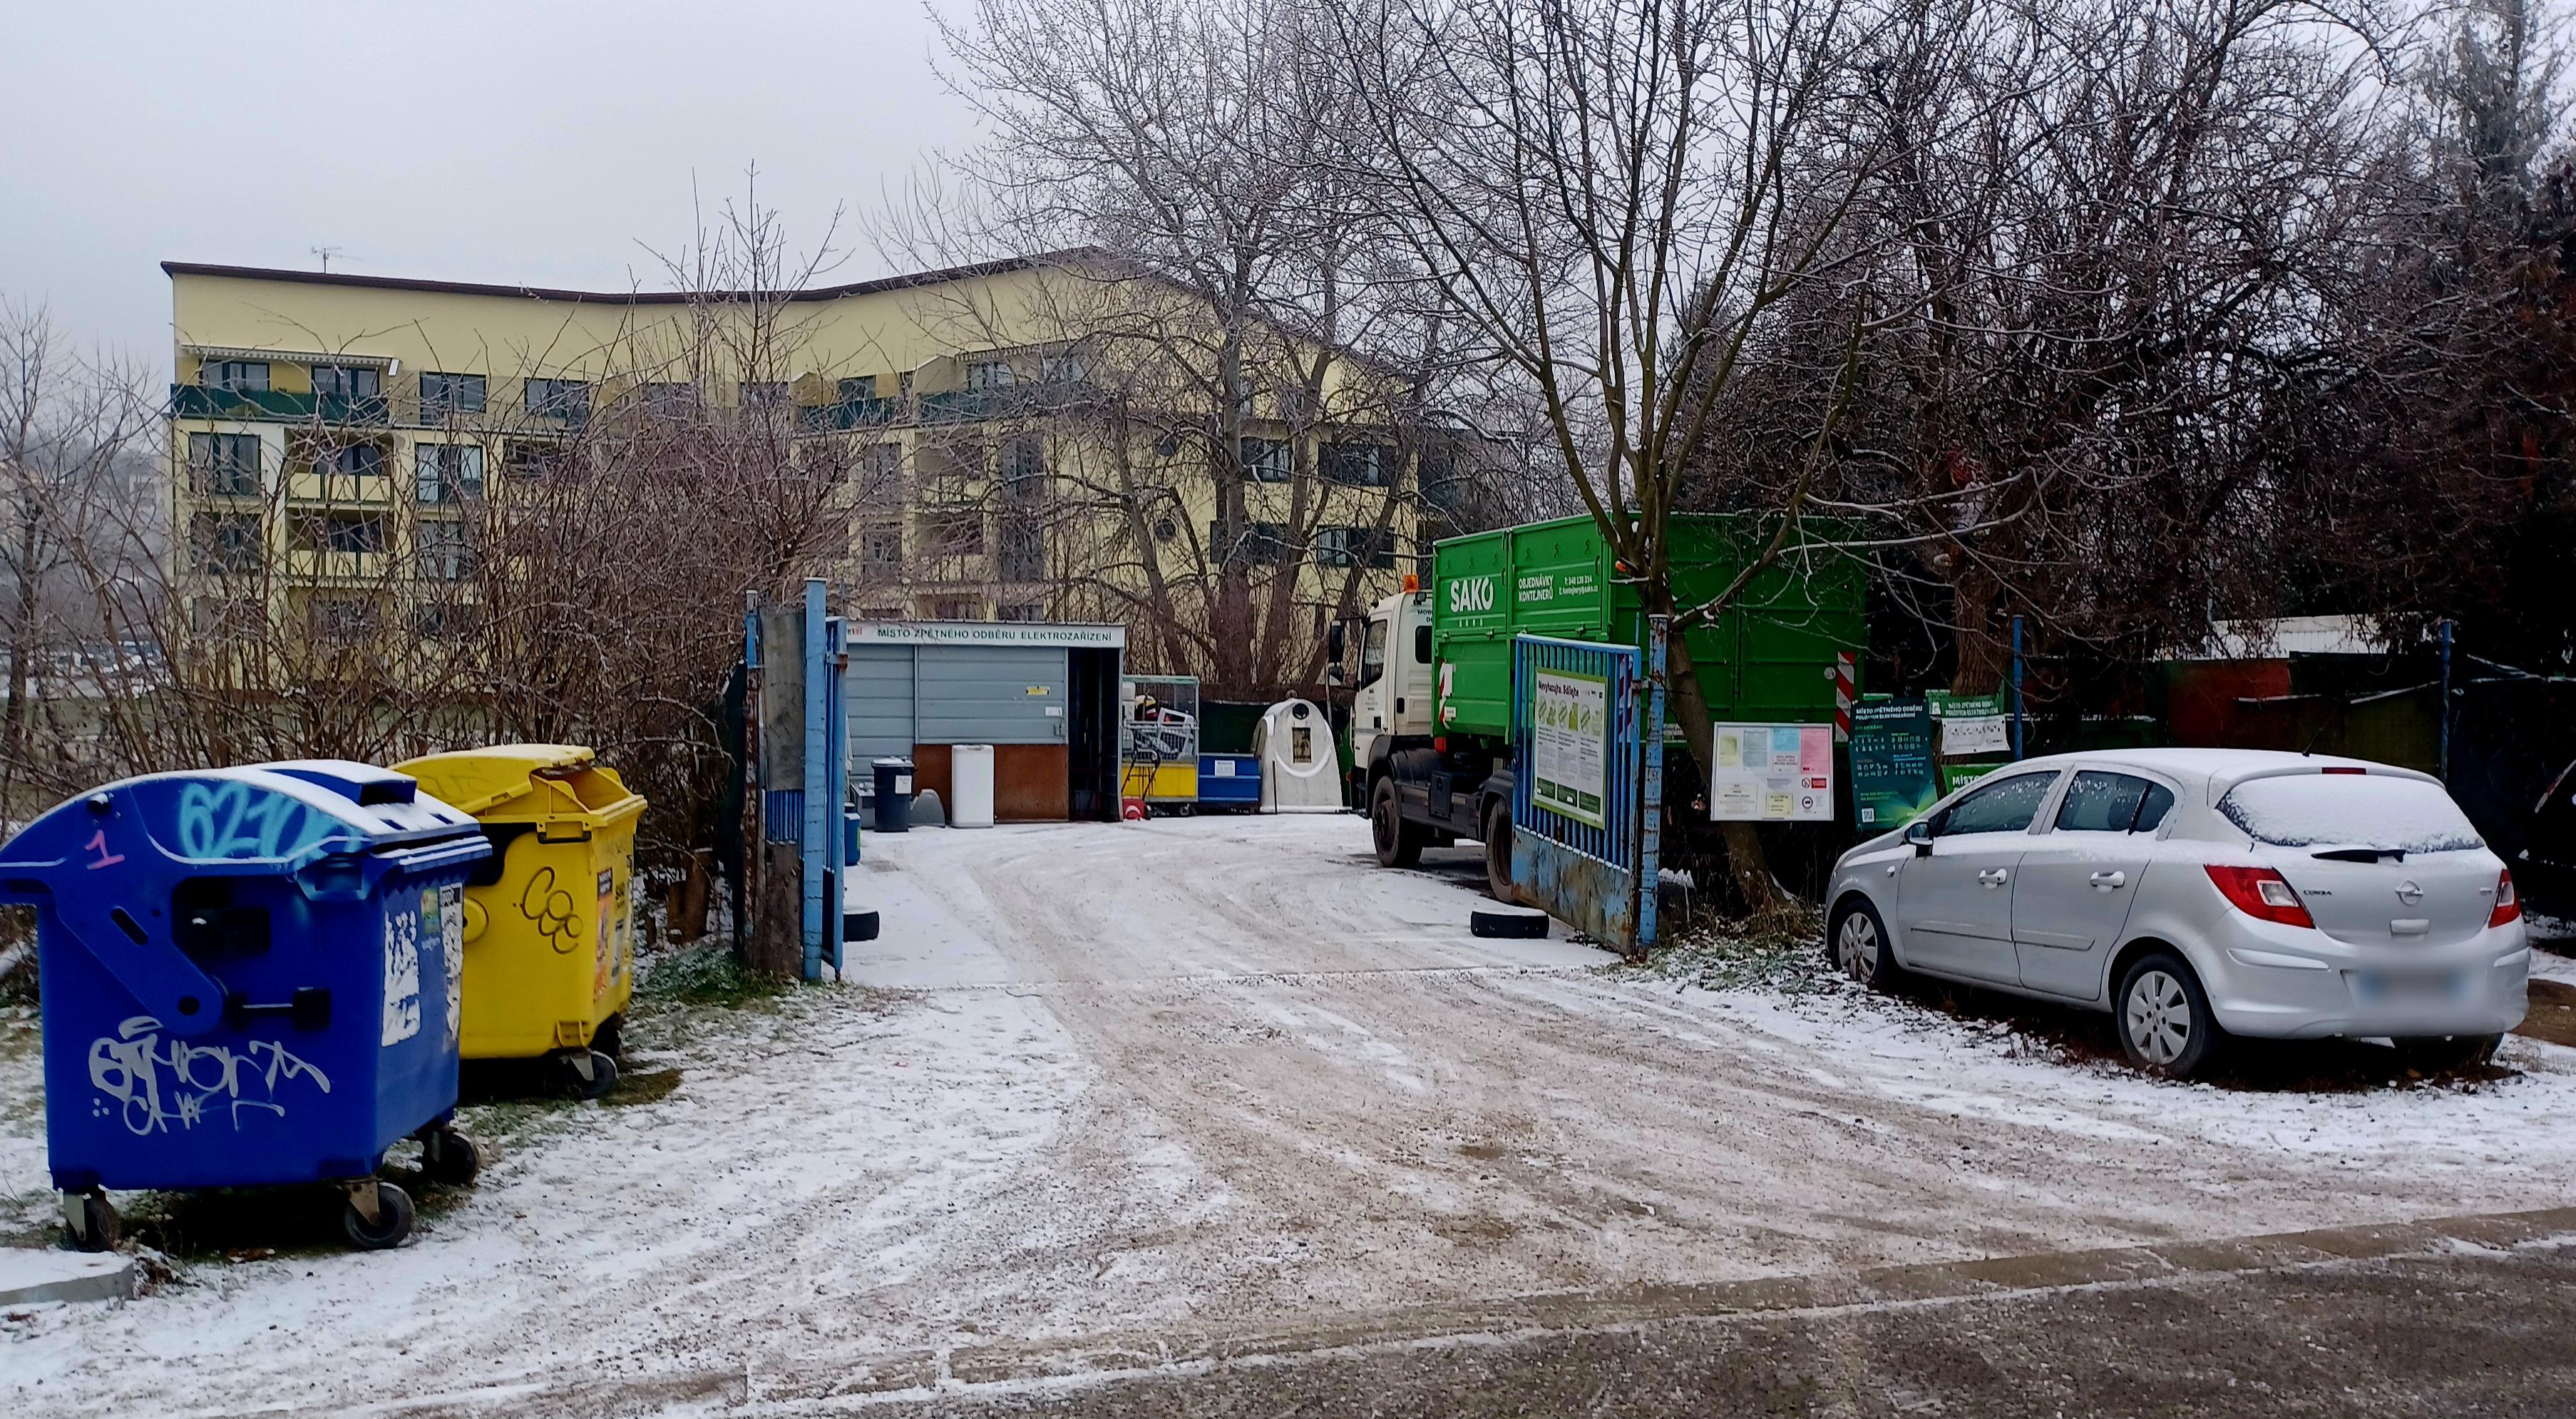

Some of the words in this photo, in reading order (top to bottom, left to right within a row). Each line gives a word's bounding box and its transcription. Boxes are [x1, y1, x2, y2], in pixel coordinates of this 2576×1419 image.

[1519, 573, 1554, 589] OBJEDNÁVKY
[1450, 576, 1494, 613] SAKO
[1519, 586, 1554, 603] KONTEJNERŮ
[878, 626, 910, 638] MÍSTO
[973, 628, 1015, 640] ODBĚRU
[1021, 630, 1112, 642] ELEKTROZAŘÍZENÍ
